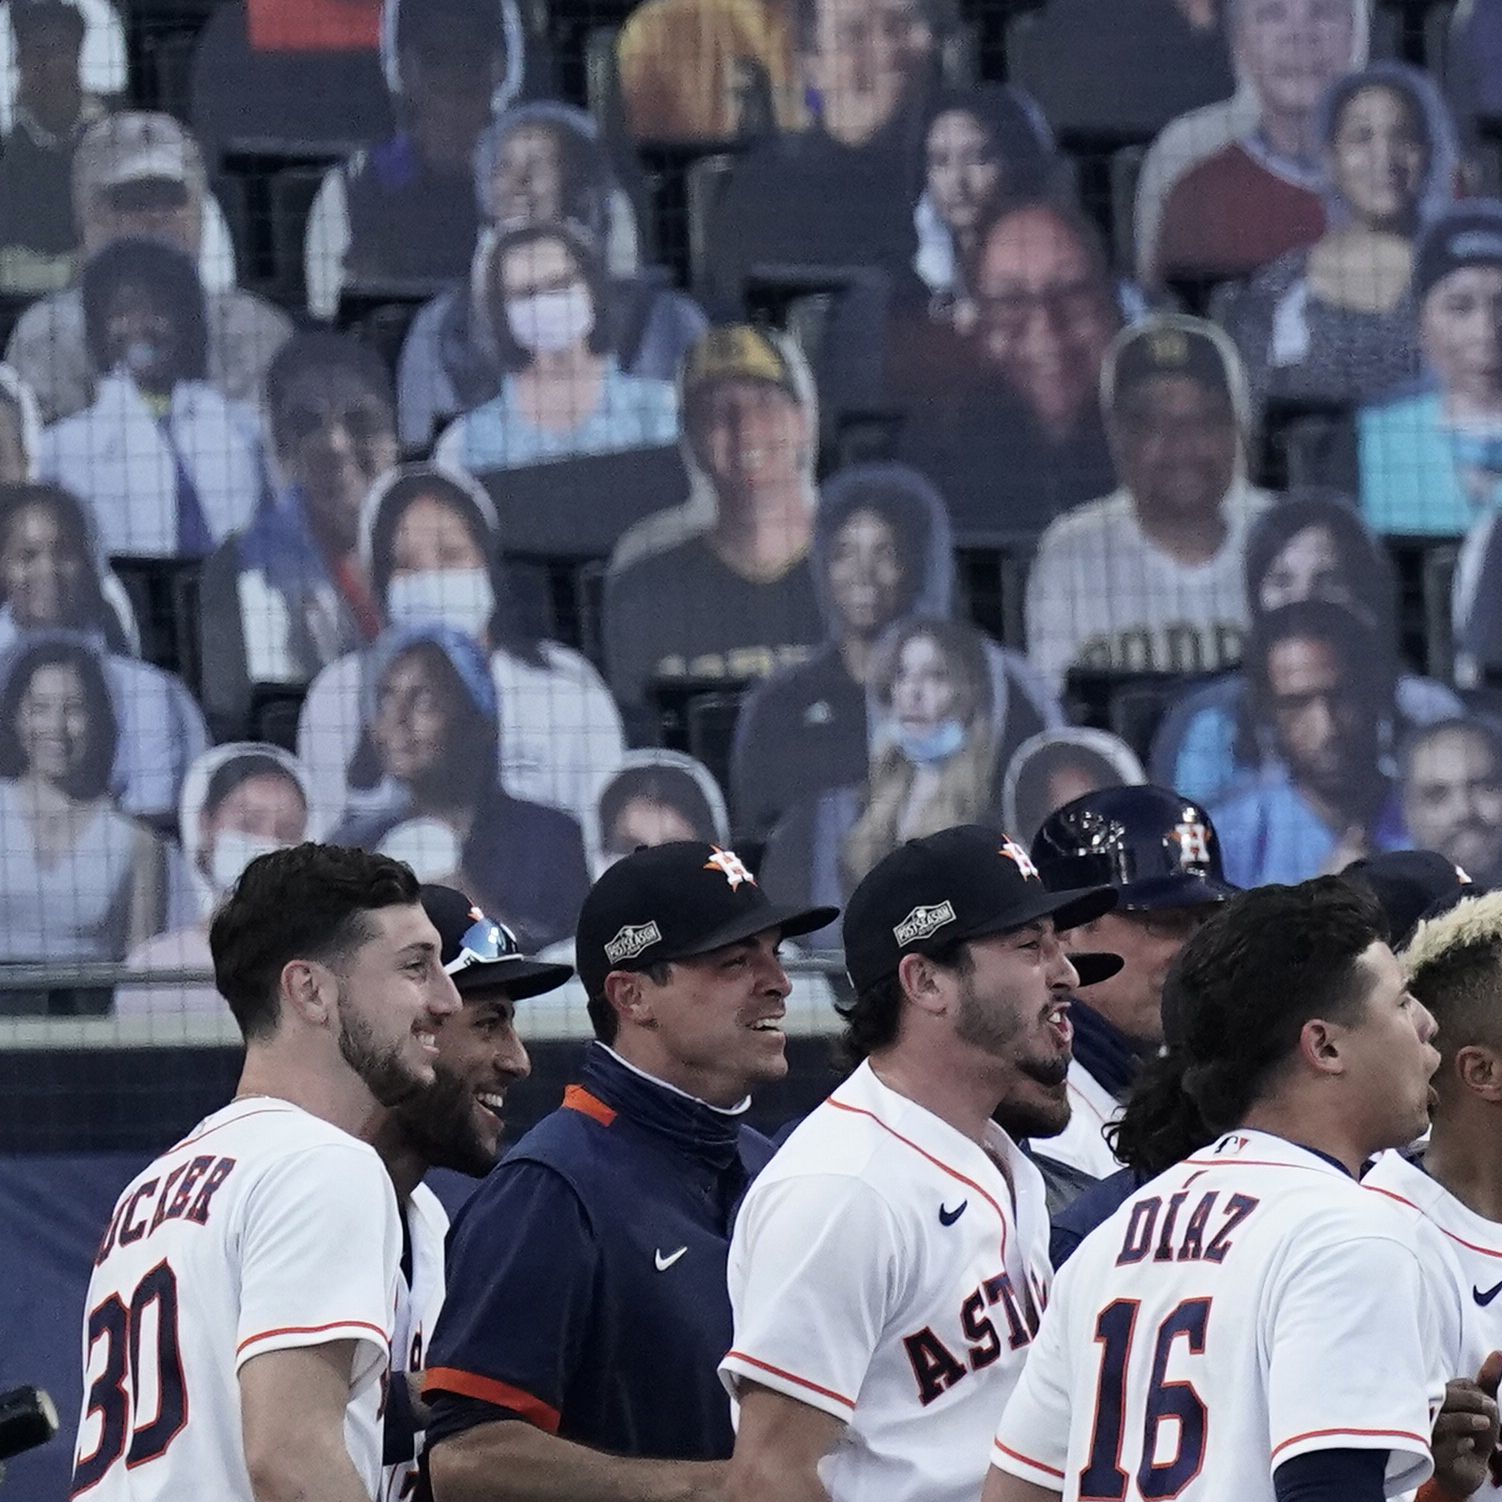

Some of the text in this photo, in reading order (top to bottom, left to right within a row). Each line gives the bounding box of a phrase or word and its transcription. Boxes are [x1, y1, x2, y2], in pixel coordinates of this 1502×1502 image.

[606, 925, 658, 957] POSTSEASON
[898, 905, 953, 941] POSTSEASON
[1114, 1168, 1262, 1268] DÍAZ
[70, 1256, 189, 1500] 30
[1076, 1296, 1210, 1502] 16
